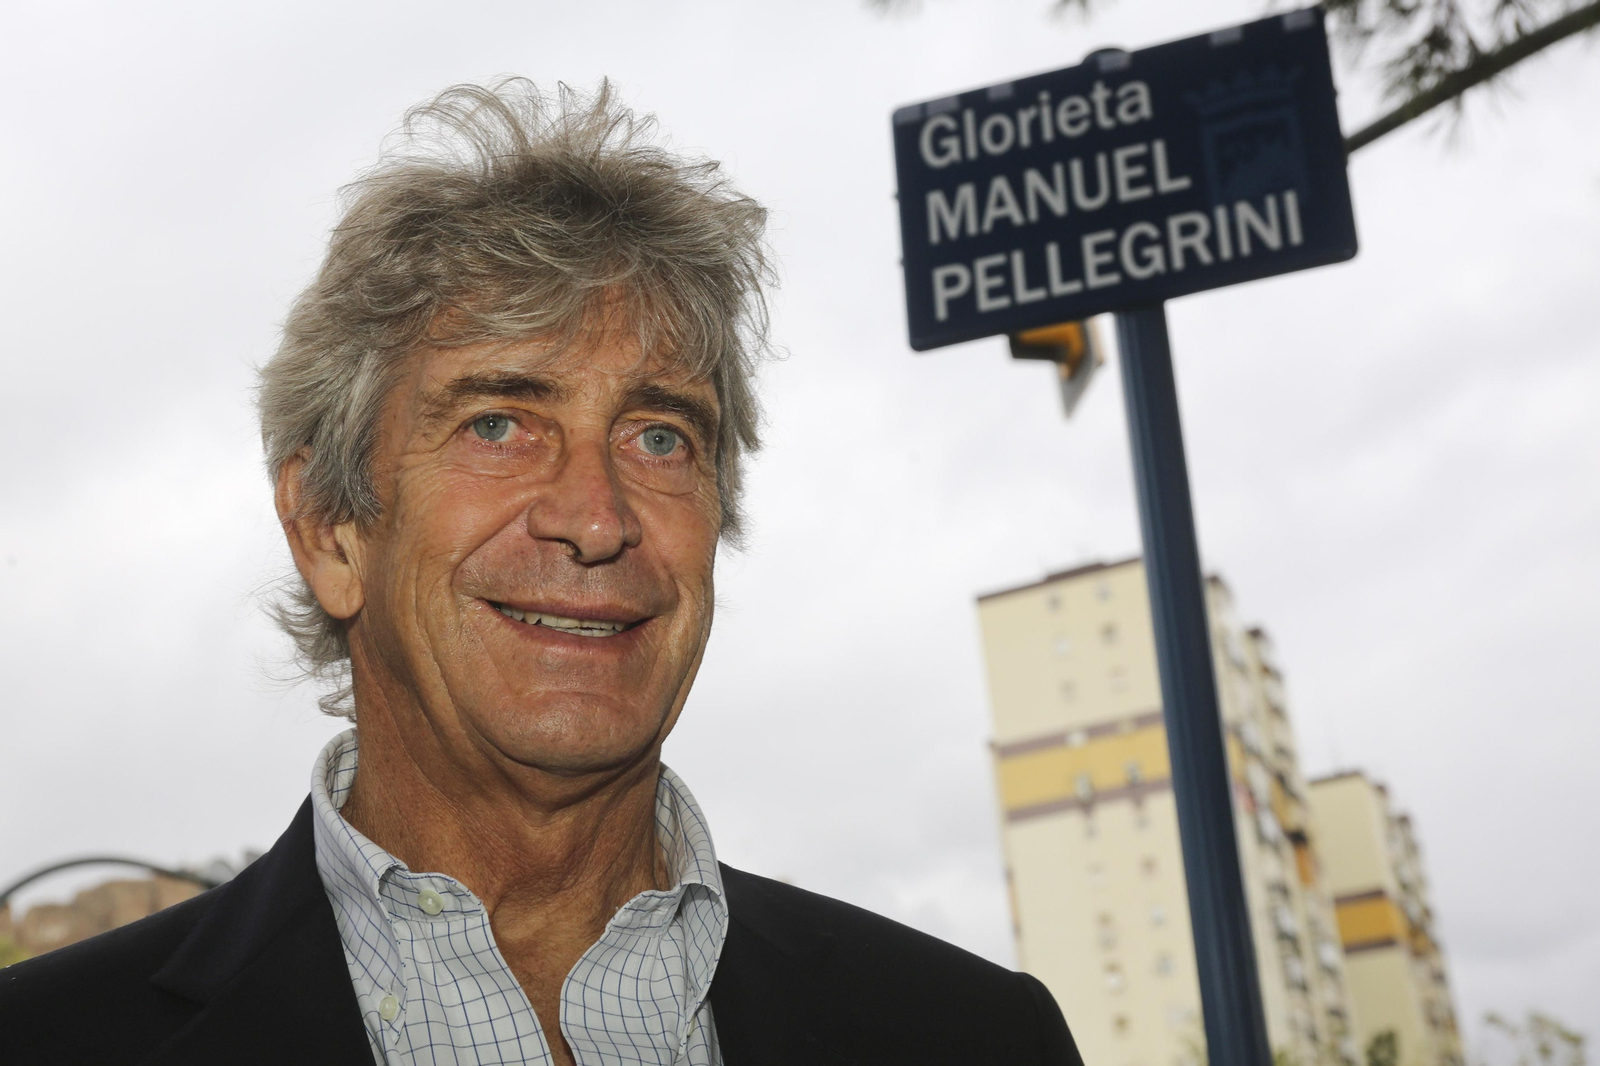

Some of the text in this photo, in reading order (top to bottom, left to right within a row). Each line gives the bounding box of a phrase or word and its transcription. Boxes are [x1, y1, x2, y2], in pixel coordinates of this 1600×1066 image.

[920, 81, 1152, 168] Glorieta
[926, 140, 1191, 244] MANUEL
[932, 191, 1303, 321] PELLEGRINI
